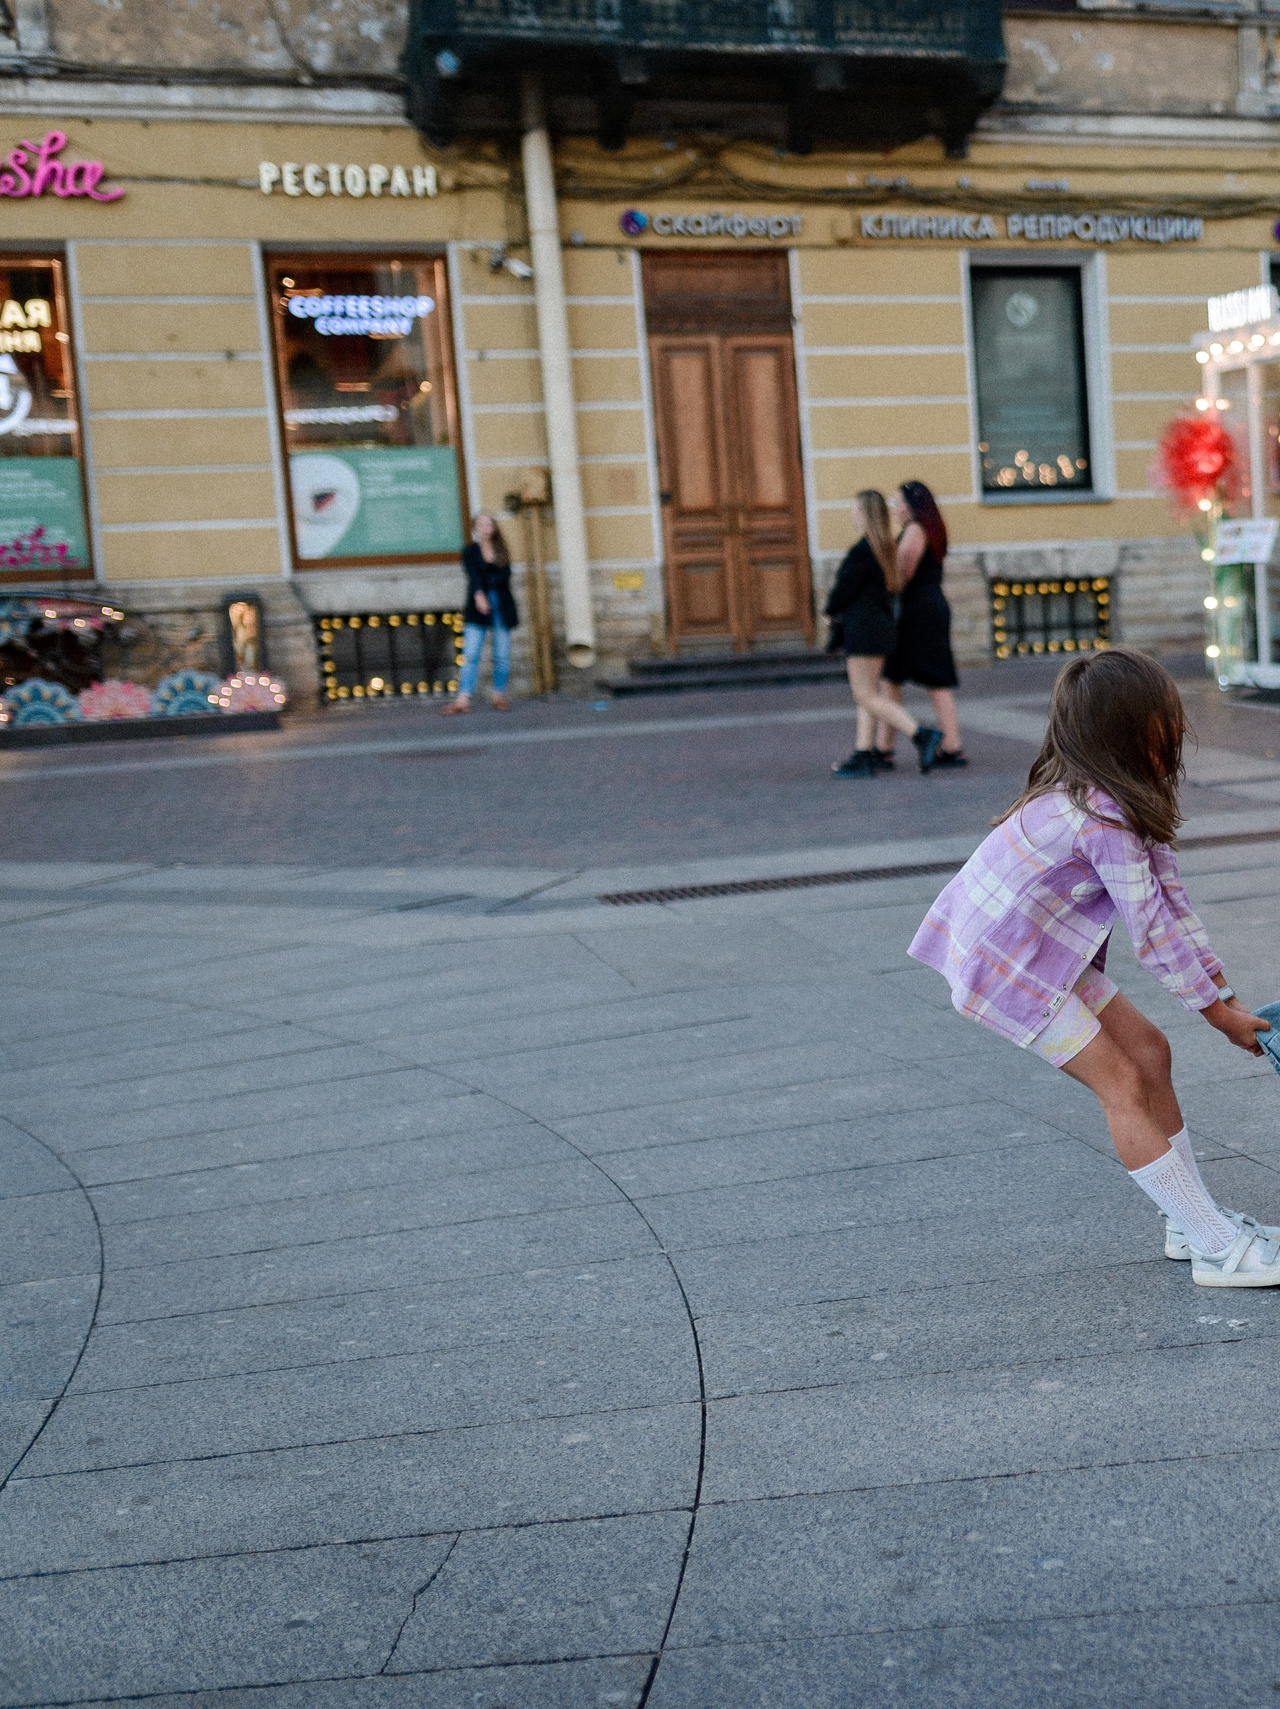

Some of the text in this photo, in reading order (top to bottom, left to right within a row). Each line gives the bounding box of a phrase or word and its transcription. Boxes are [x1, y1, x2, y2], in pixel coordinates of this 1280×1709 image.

[0, 131, 125, 200] sha
[258, 161, 437, 197] РЕСТОРАН
[861, 214, 1203, 243] КЛИНИКА РЕПРОДУКЦИИ
[0, 298, 51, 328] АЯ
[288, 295, 435, 318] COFFEESHOP
